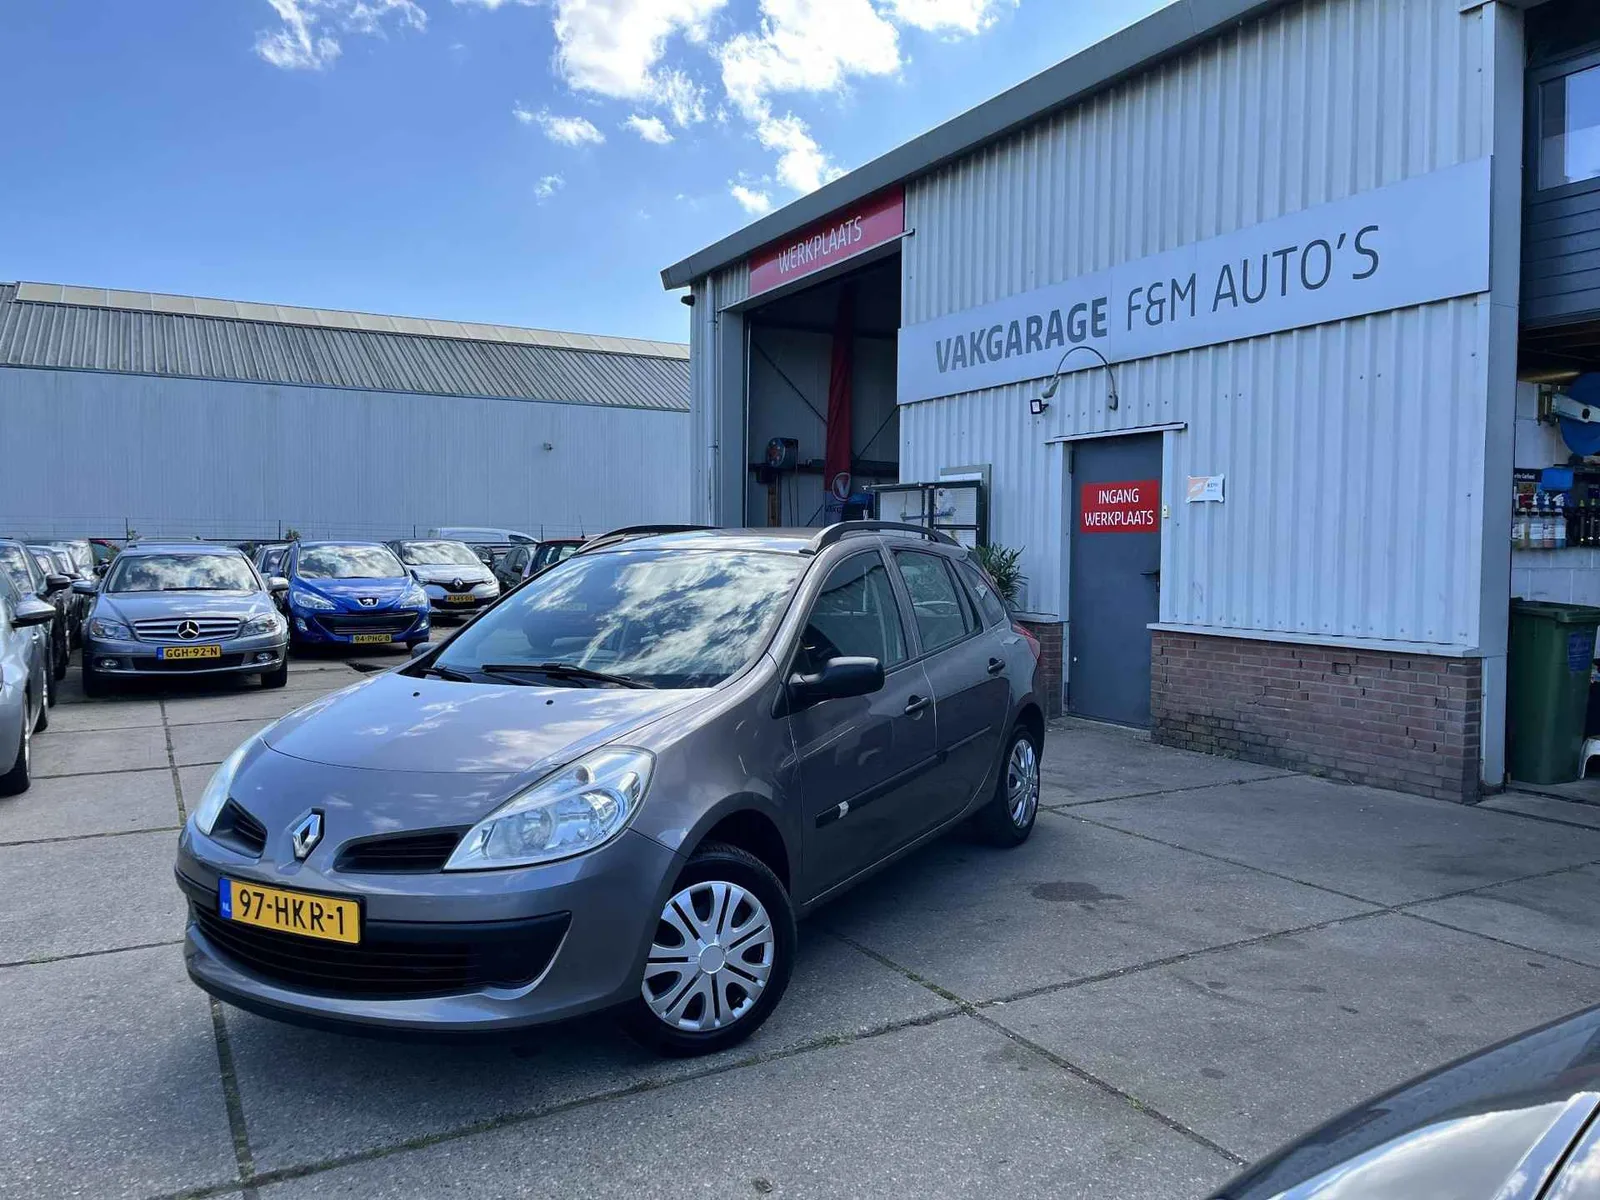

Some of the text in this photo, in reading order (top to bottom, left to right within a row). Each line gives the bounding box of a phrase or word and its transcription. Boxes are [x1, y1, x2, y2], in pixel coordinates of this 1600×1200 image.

[778, 215, 862, 274] WERKPLAATS
[936, 225, 1379, 374] VAKGARAGE F&M AUTO'S
[1098, 488, 1140, 504] INGANG
[1085, 510, 1154, 526] WERKPLAATS
[166, 647, 218, 658] GGH-92-N
[239, 889, 344, 935] 97-HKR-1
